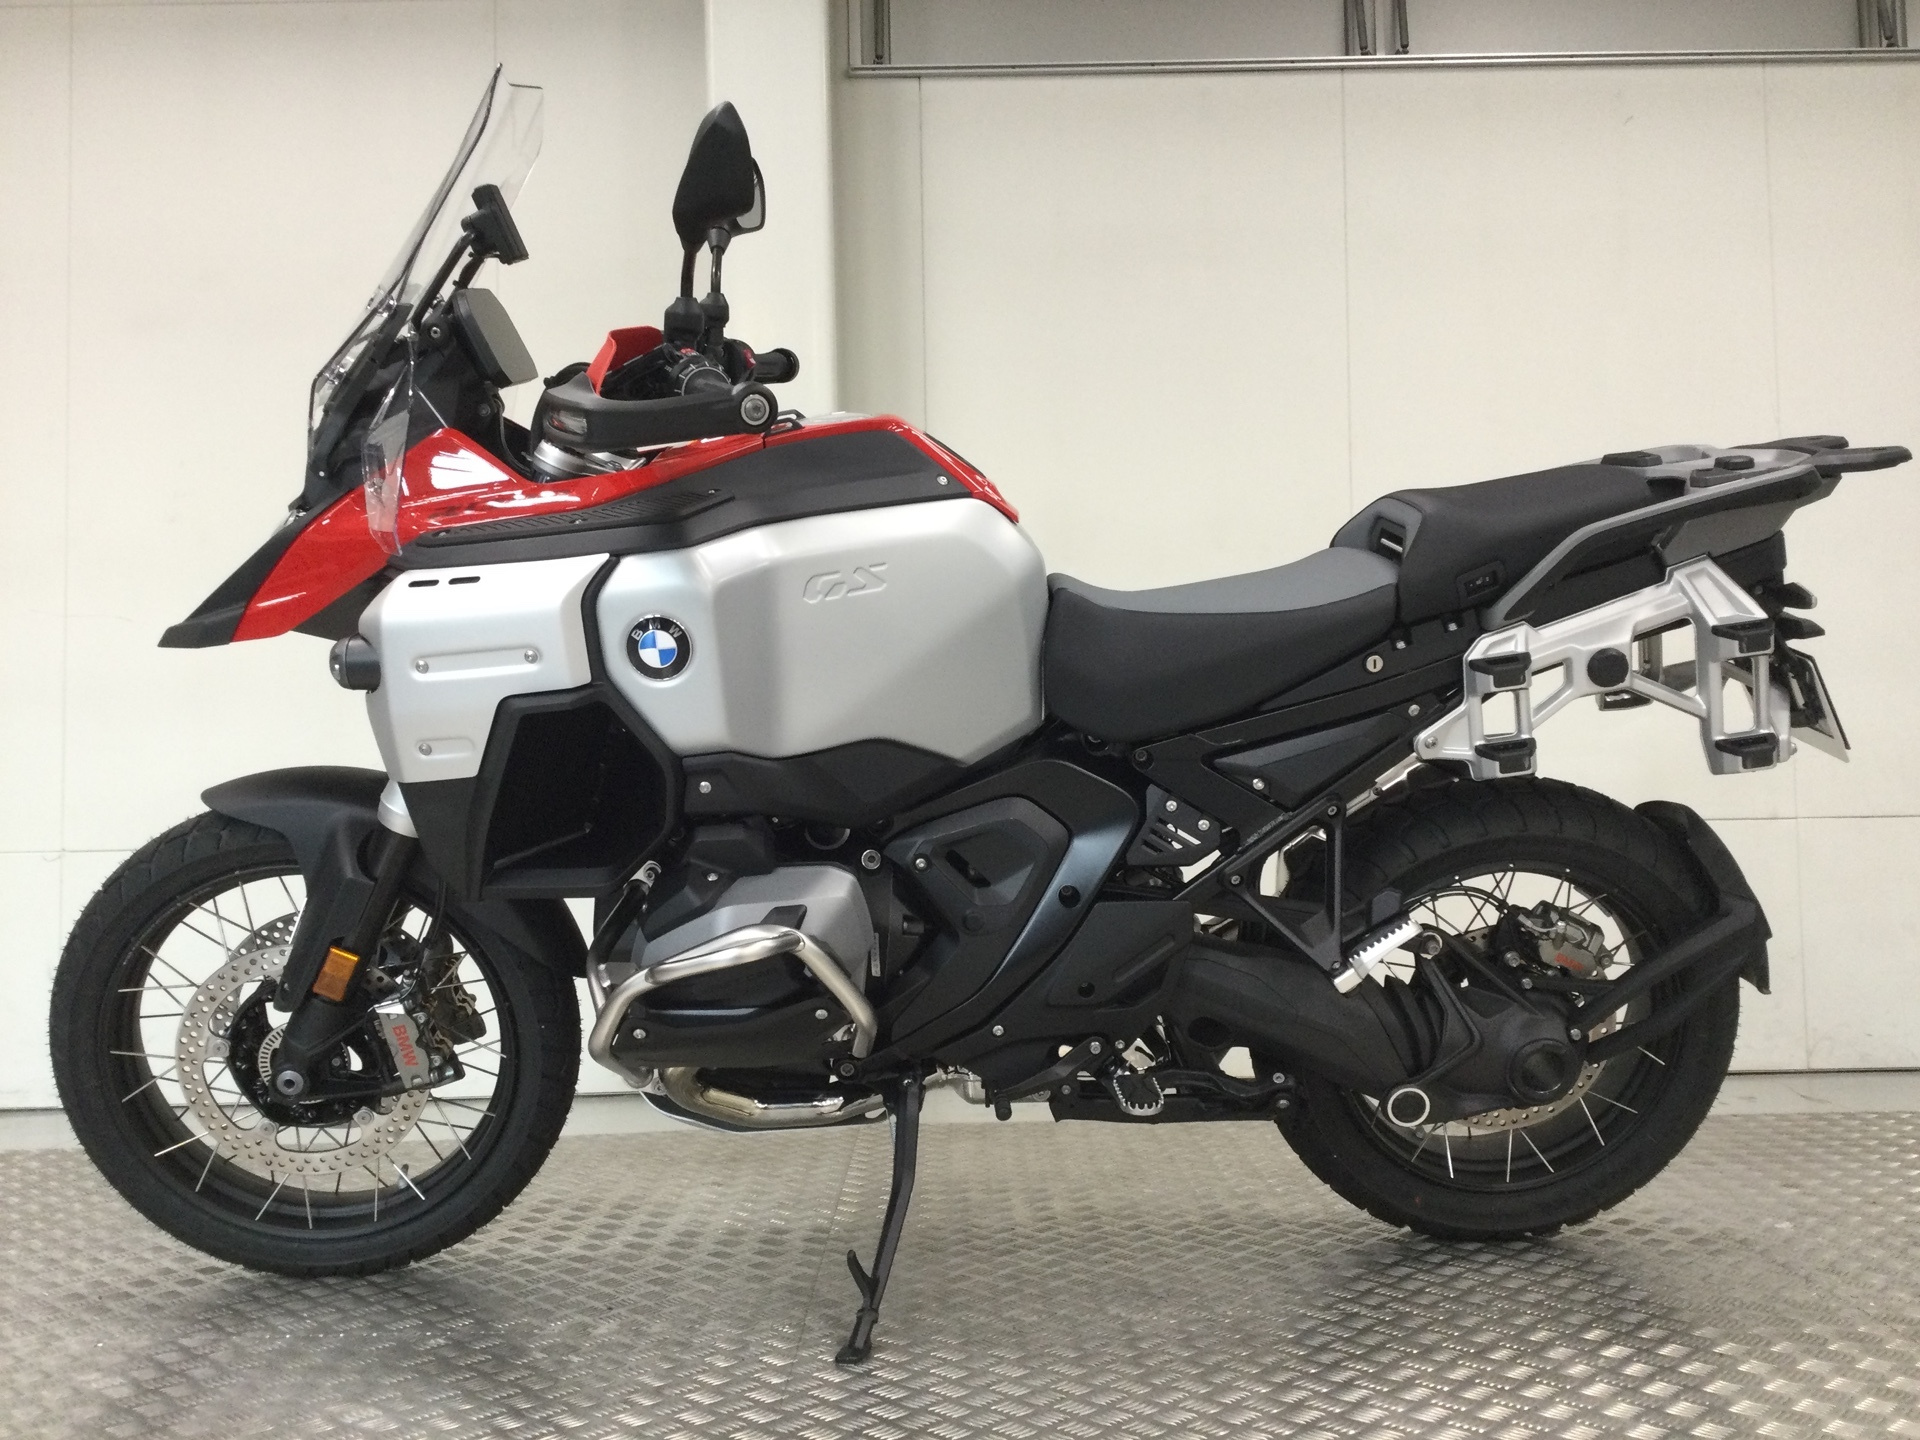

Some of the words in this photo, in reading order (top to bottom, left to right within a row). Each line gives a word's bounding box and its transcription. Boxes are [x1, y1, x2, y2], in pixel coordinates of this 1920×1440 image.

[803, 562, 888, 604] GS
[631, 620, 683, 640] BMW
[392, 1024, 419, 1067] BMW
